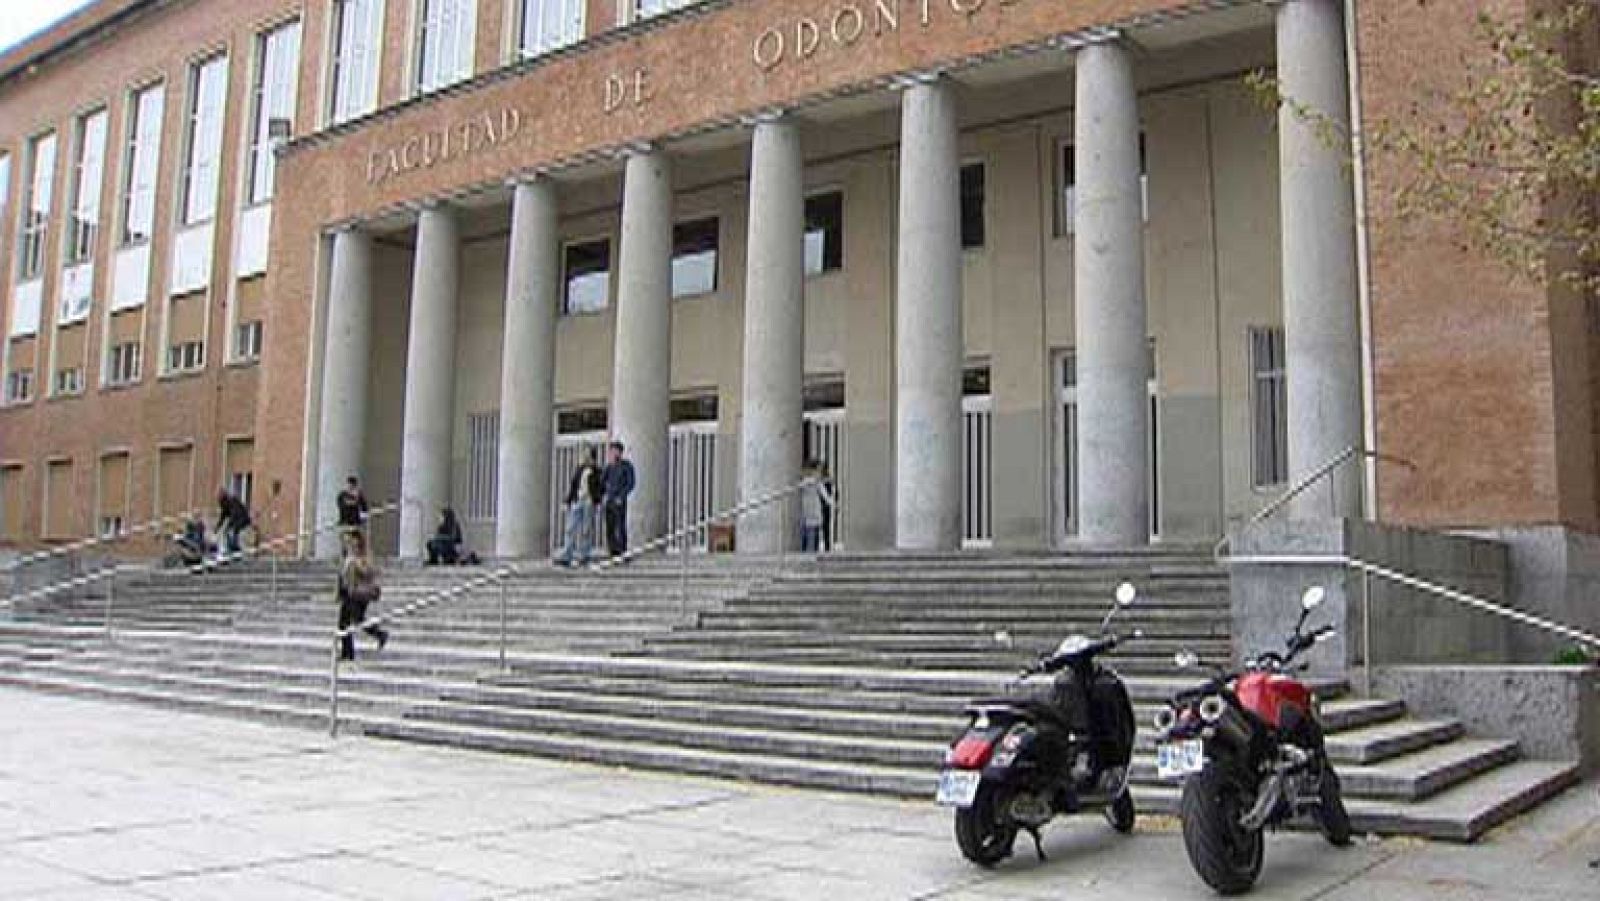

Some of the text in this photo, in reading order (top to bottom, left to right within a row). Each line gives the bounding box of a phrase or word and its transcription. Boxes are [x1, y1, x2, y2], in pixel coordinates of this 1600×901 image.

[366, 0, 982, 184] FACULTAD DE ODONT
